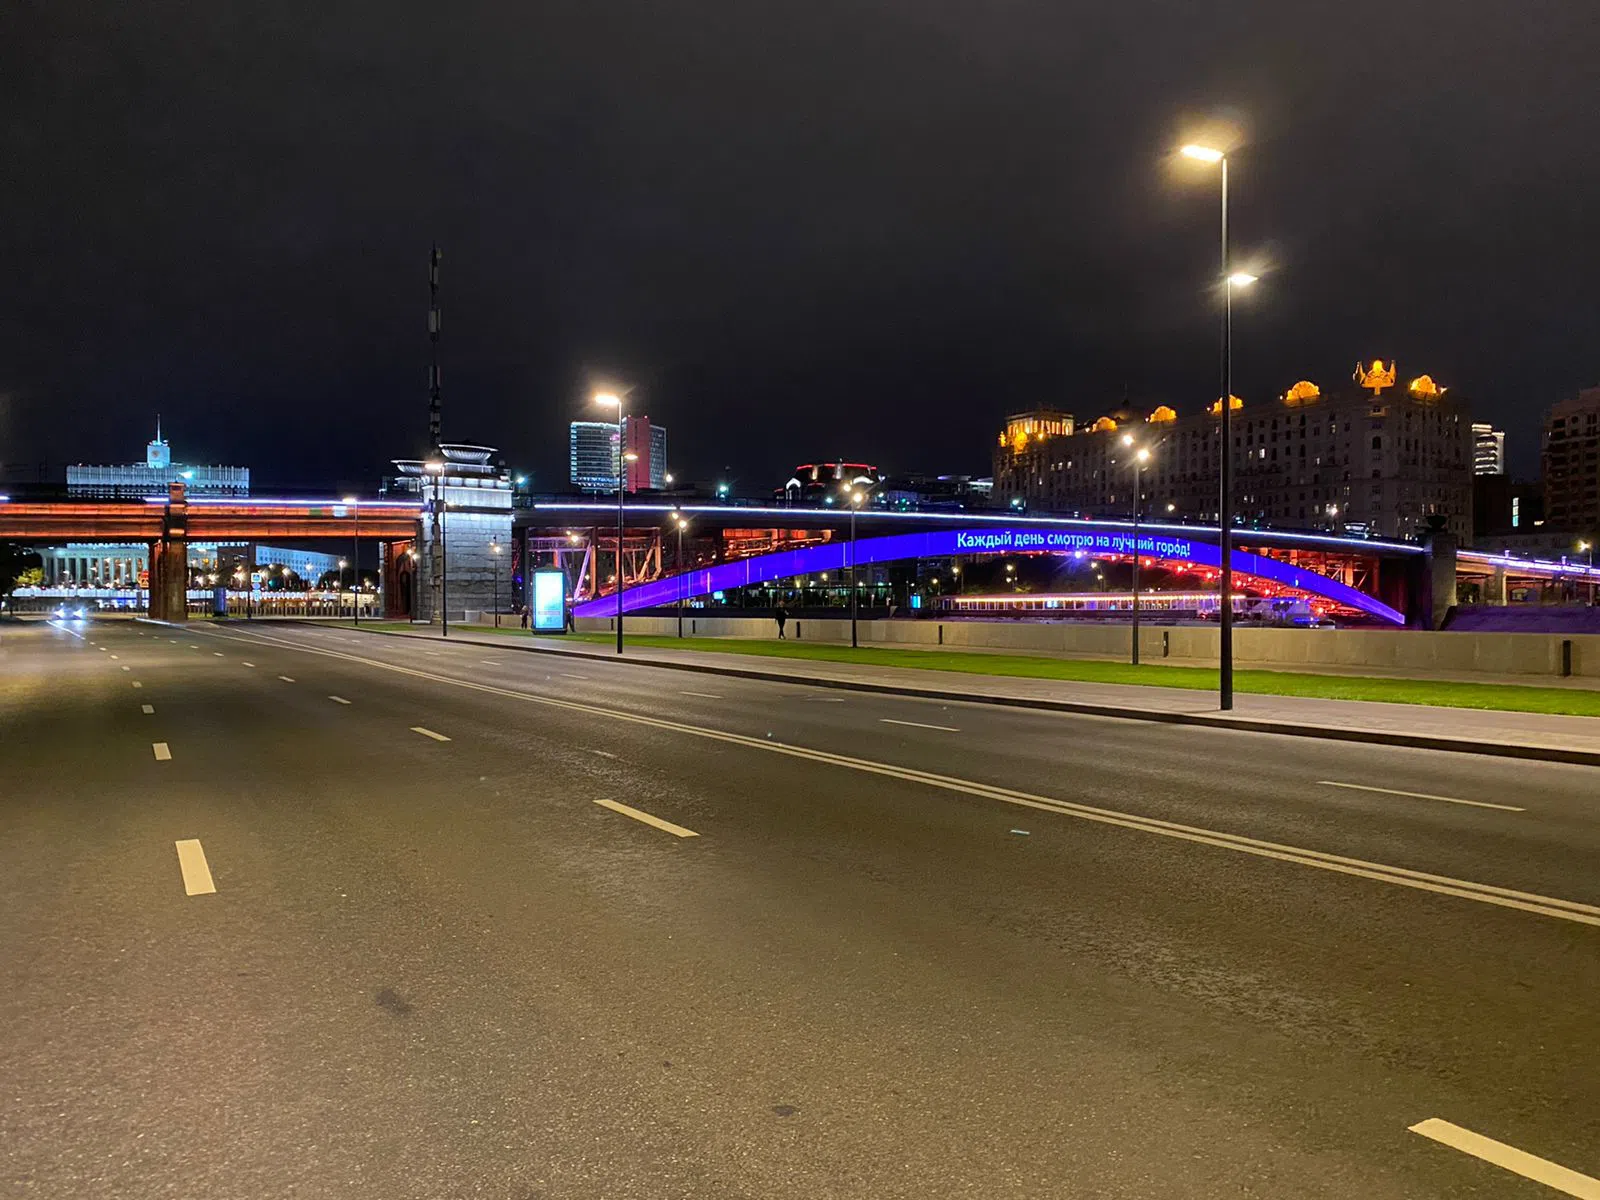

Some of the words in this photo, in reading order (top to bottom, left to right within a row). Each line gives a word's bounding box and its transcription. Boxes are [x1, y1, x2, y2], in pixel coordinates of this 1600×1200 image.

[957, 530, 1011, 548] Каждый
[1014, 533, 1044, 547] день
[1047, 534, 1094, 548] смотрю
[1096, 535, 1110, 547] на
[1156, 541, 1190, 557] город!
